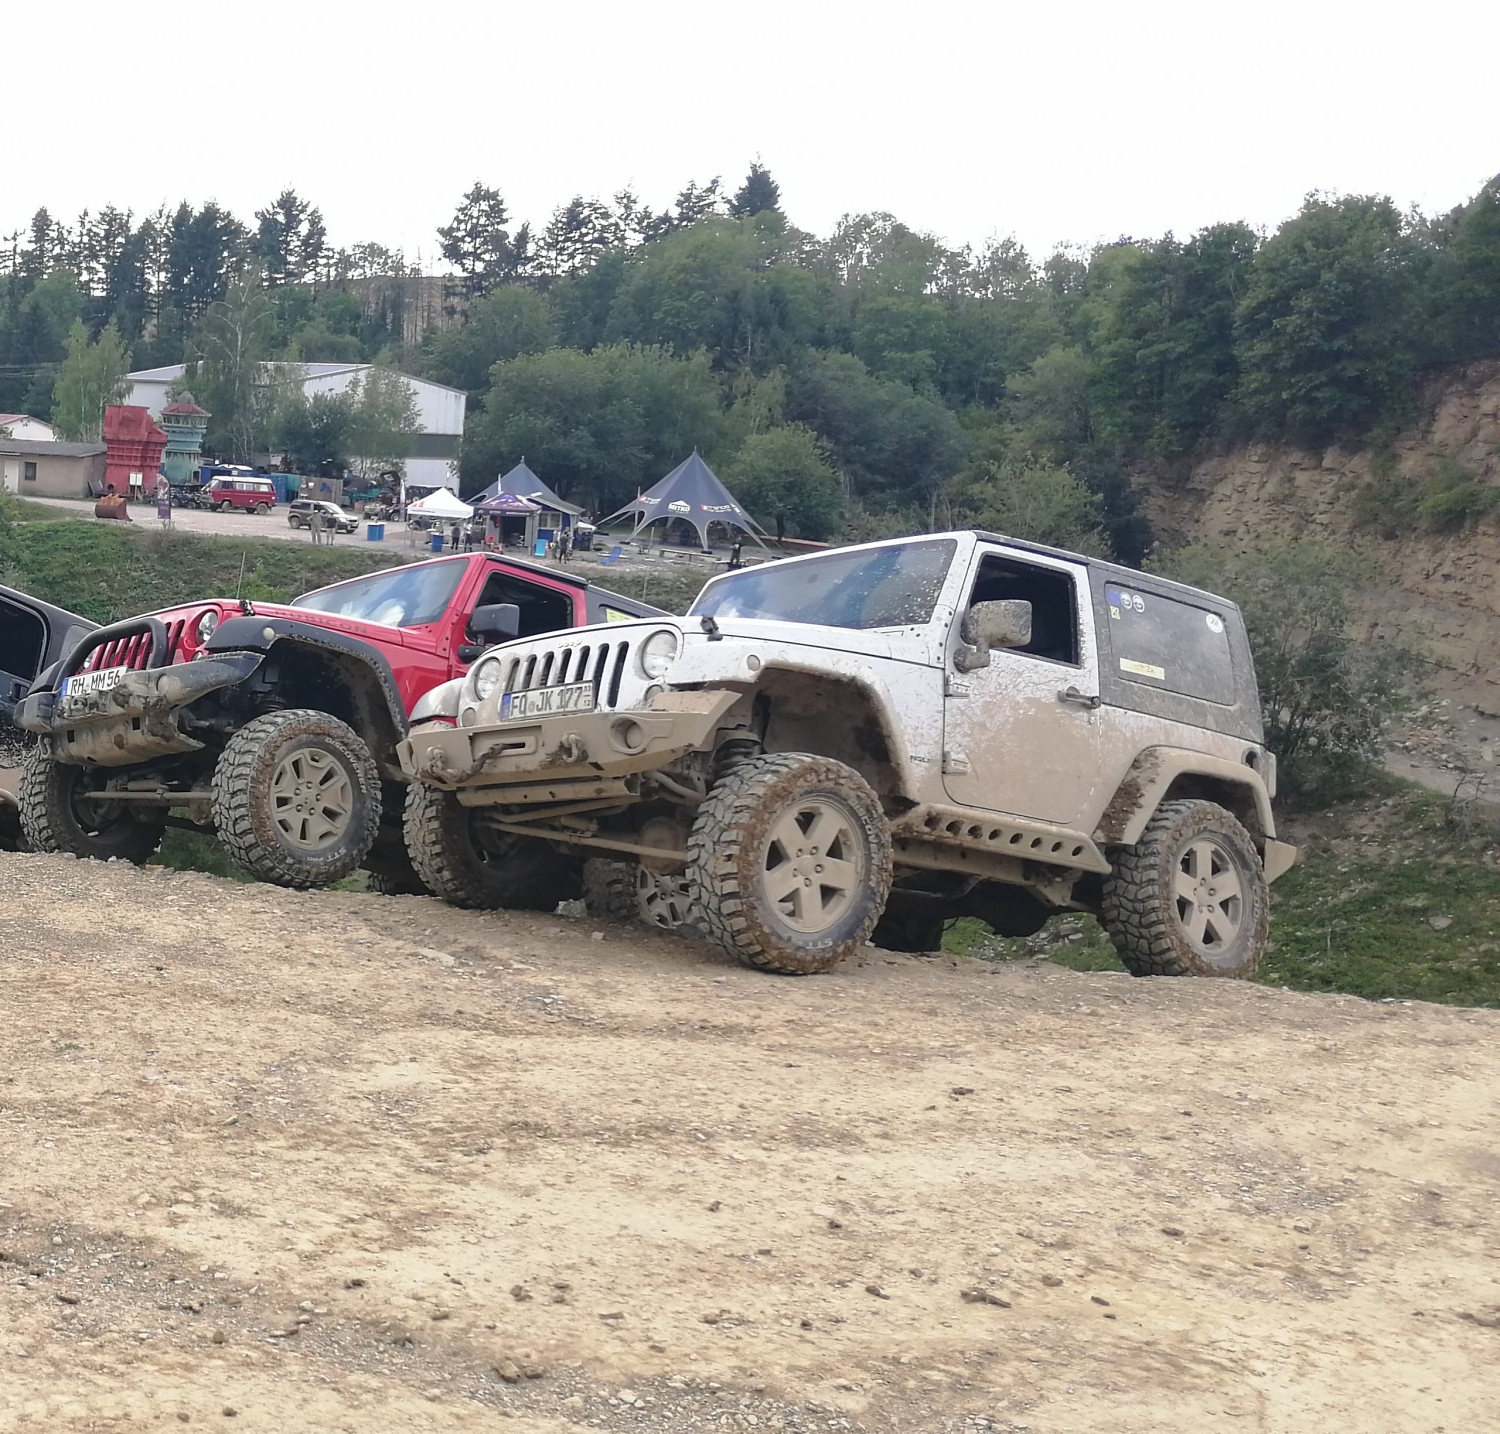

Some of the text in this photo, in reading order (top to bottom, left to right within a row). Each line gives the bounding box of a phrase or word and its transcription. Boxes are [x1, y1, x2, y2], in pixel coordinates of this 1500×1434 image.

[70, 669, 120, 695] RH MM 56
[511, 686, 583, 716] FO JK 177
[326, 846, 347, 862] STT
[806, 937, 833, 950] STT
